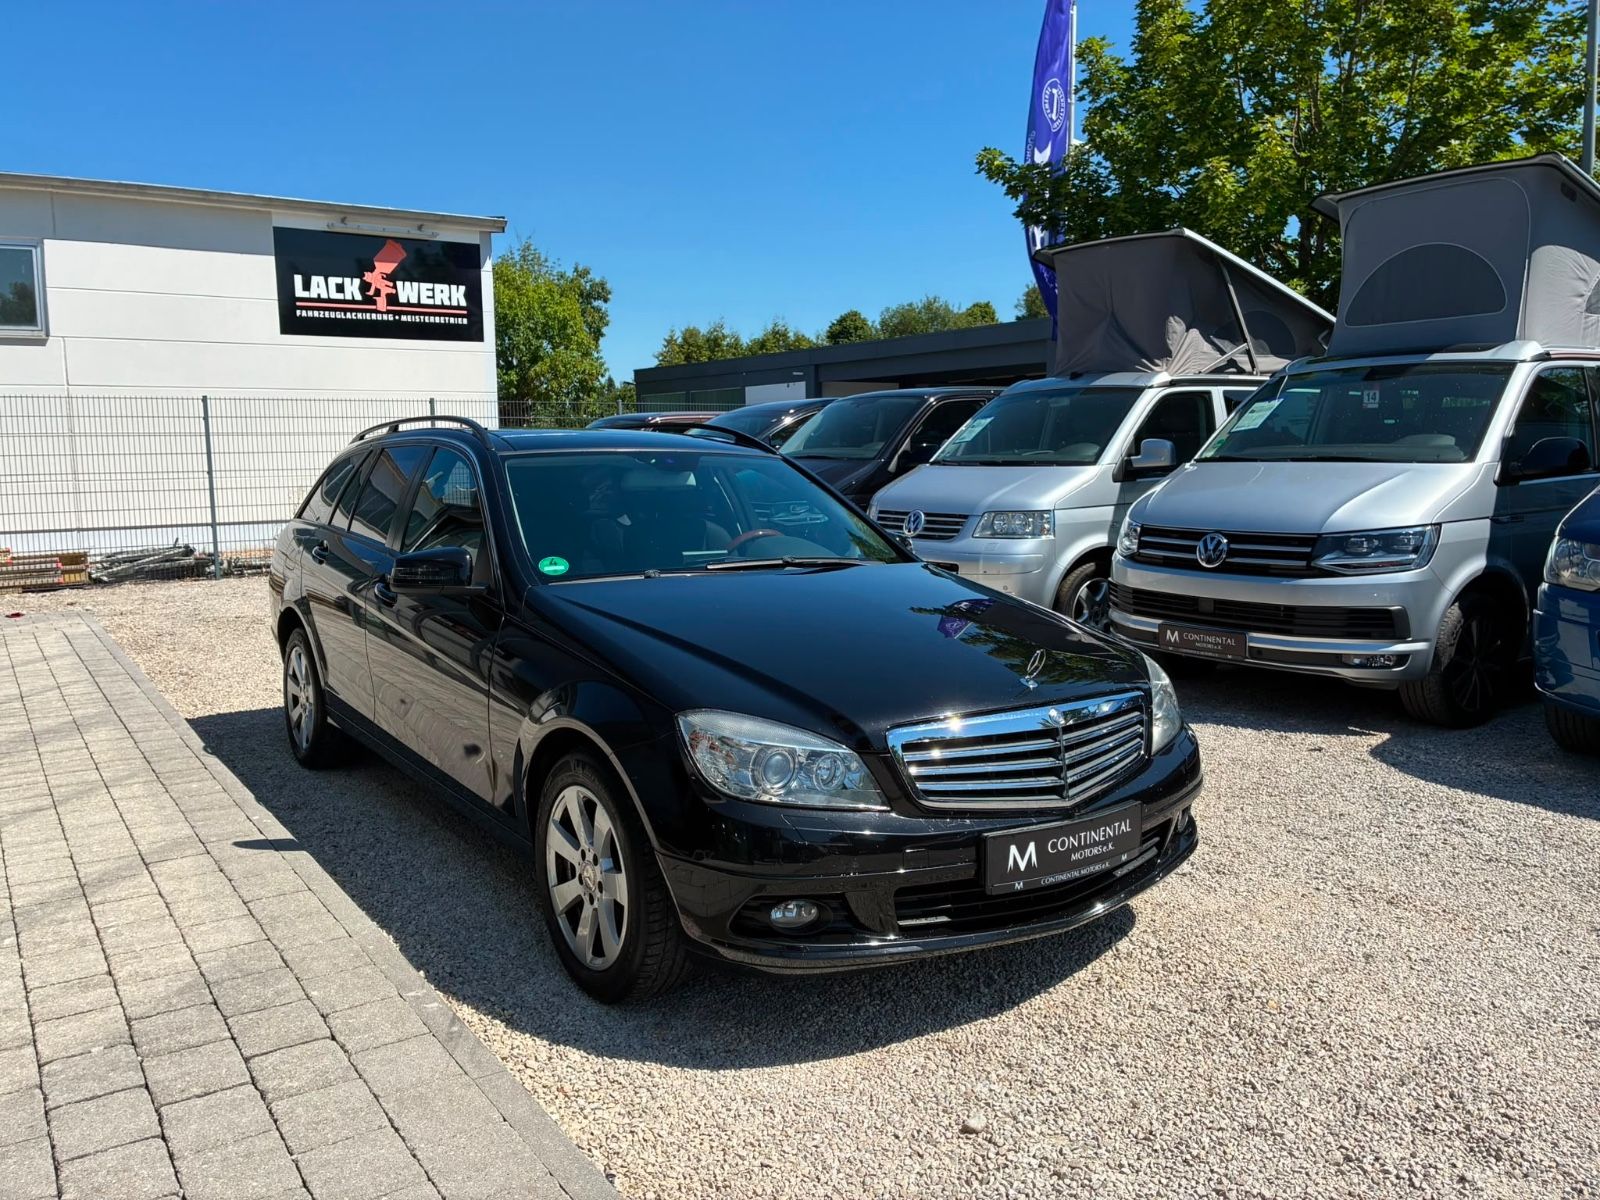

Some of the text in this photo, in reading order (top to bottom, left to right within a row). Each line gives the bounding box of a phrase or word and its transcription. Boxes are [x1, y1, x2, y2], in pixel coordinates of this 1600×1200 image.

[293, 274, 467, 307] LACK WERK
[295, 309, 468, 325] FAHRZEUGLACKIERUNG MEISTERBETRIEB
[1166, 629, 1236, 646] M CONTINENTAL
[1007, 818, 1132, 872] M CONTINENTAL
[1070, 845, 1103, 862] MOTORS
[1040, 871, 1081, 886] CONTINENTAL
[1080, 863, 1102, 876] MOTORS
